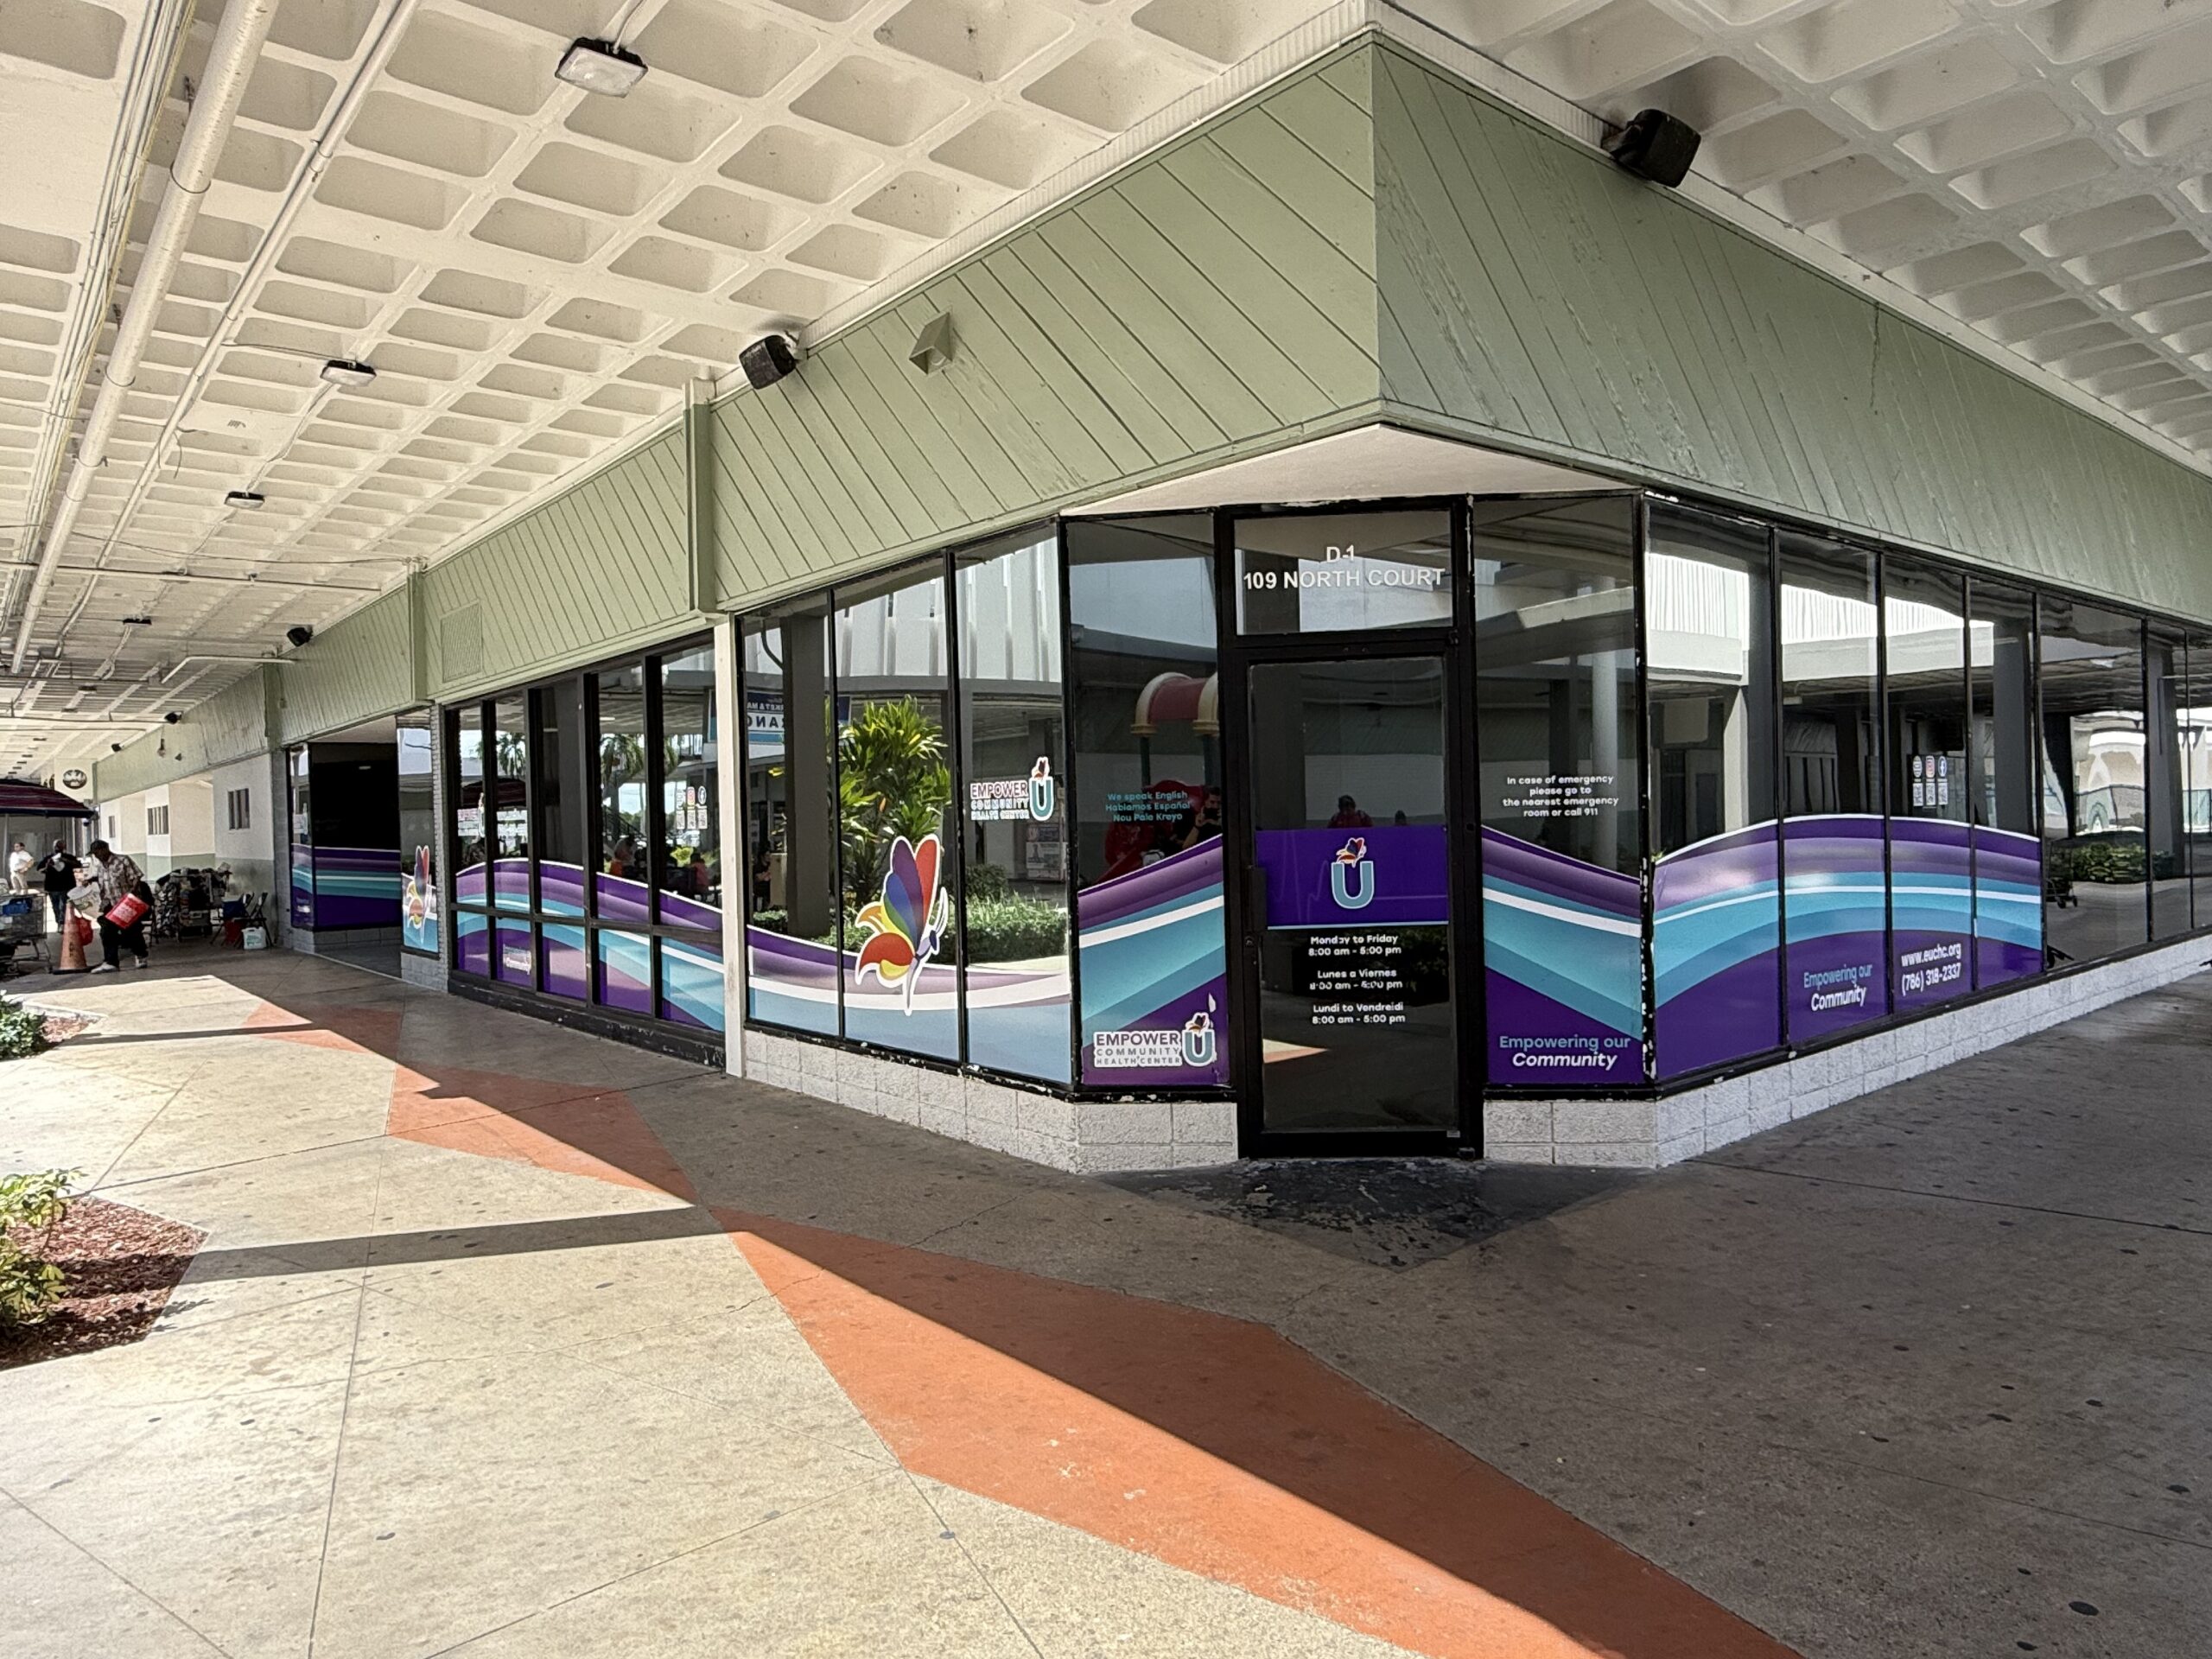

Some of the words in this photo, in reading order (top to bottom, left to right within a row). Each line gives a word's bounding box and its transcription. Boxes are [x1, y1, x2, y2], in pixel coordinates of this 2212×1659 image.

[1325, 544, 1355, 563] D-1
[1243, 571, 1277, 590] 109
[1284, 569, 1361, 589] NORTH
[1368, 568, 1446, 587] COURT
[1507, 776, 1516, 785] In
[1545, 775, 1556, 785] of
[1558, 776, 1614, 785] emergency
[970, 780, 1028, 799] EMPOWER
[1529, 787, 1562, 797] please
[1565, 787, 1578, 797] go
[1580, 786, 1592, 795] to
[1124, 792, 1153, 802] speak
[1155, 791, 1188, 801] English
[1503, 798, 1520, 806] the
[1522, 798, 1561, 806] nearest
[1563, 797, 1619, 807] emergency
[971, 798, 1029, 810] COMMUNITY
[1154, 801, 1190, 811] Español
[1564, 807, 1582, 817] call
[1584, 807, 1599, 816] 911
[1332, 861, 1374, 909] U
[1310, 936, 1350, 945] Monday
[1366, 934, 1398, 944] Friday
[1308, 947, 1332, 957] 8:00
[1359, 946, 1382, 955] 5:00
[1385, 946, 1402, 957] pm
[1901, 943, 1961, 967] www.euchc.org
[1317, 969, 1347, 978] Lunes
[1358, 969, 1397, 978] Viernes
[1804, 963, 1857, 990] Empowering
[1859, 963, 1873, 978] our
[1902, 969, 1924, 996] (786)
[1925, 962, 1961, 987] 318-2337
[1386, 981, 1403, 991] pm
[1811, 983, 1866, 1012] Community
[1313, 1003, 1340, 1013] Lundi
[1312, 1015, 1335, 1024] 8:00
[1338, 1015, 1354, 1024] am
[1363, 1014, 1386, 1023] 5:00
[1389, 1014, 1406, 1025] pm
[1096, 1033, 1179, 1046] EMPOWER
[1499, 1033, 1599, 1052] Empowering
[1603, 1037, 1630, 1048] our
[1096, 1047, 1179, 1056] COMMUNITY
[1512, 1050, 1618, 1071] Community
